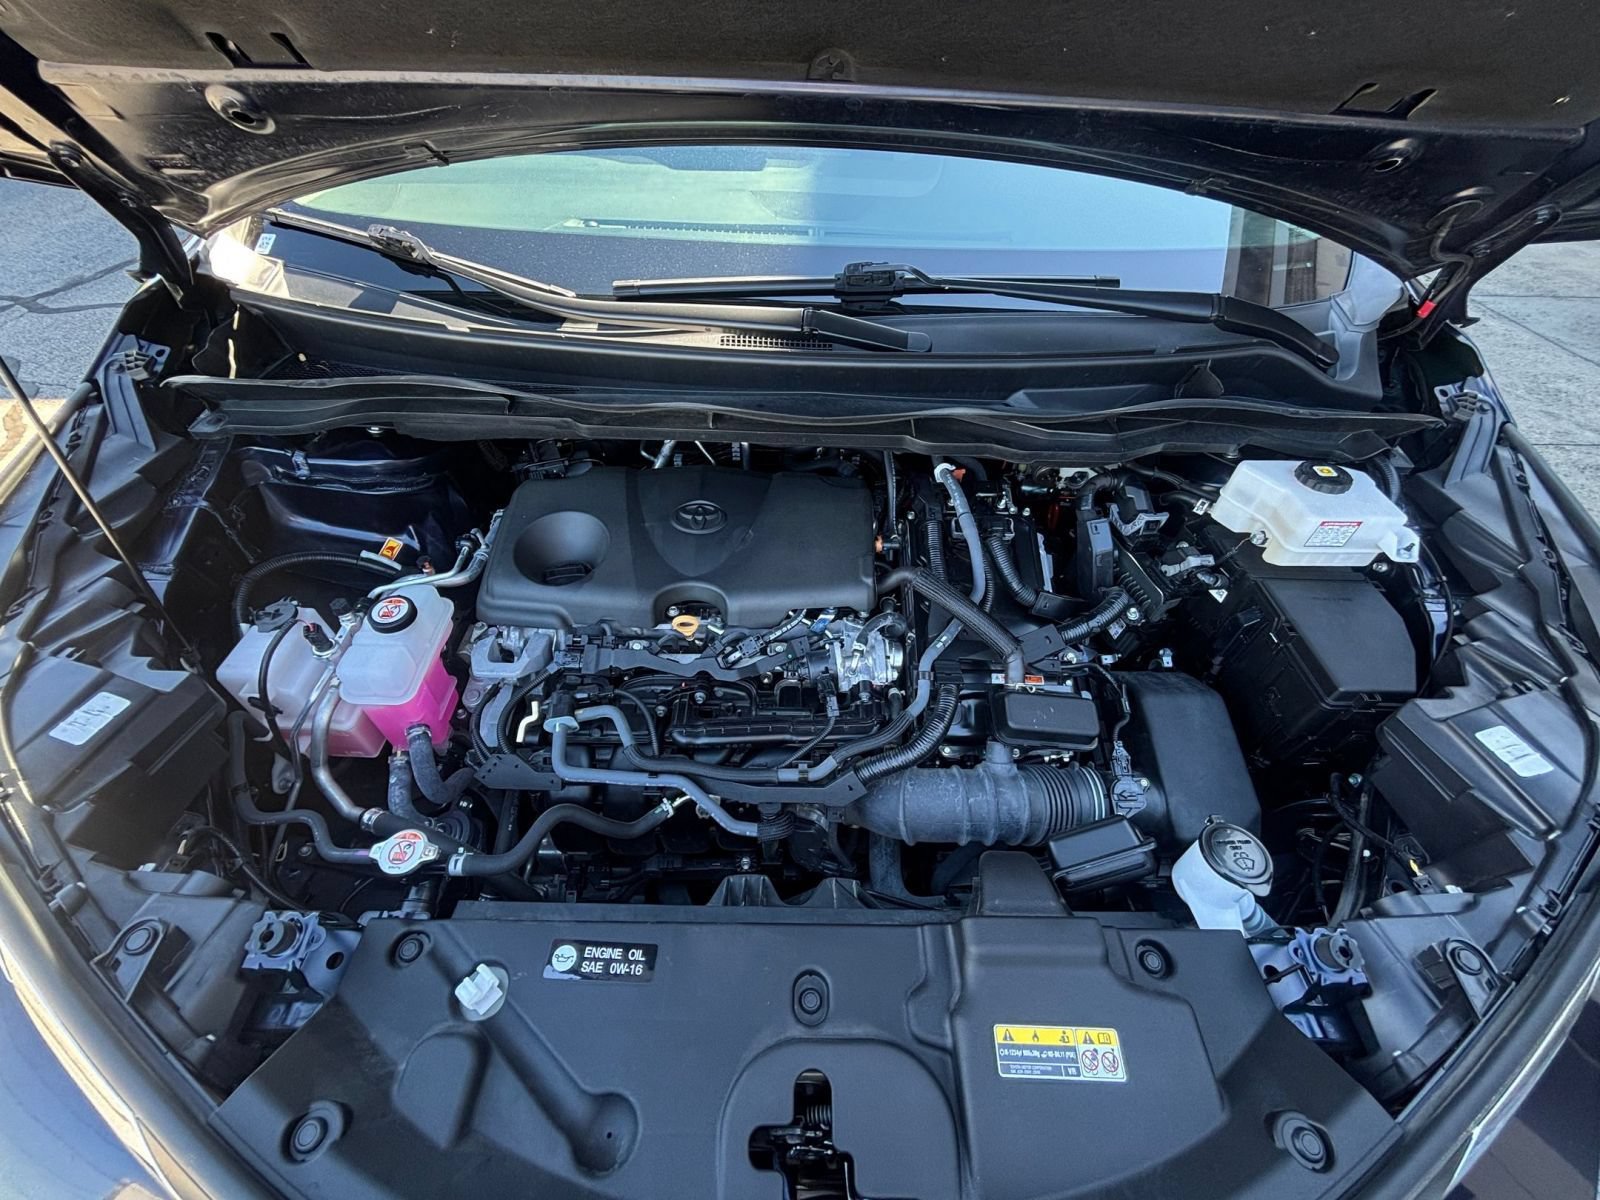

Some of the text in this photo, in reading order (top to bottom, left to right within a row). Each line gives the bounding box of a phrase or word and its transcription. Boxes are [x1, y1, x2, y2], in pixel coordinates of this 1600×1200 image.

[584, 946, 646, 961] ENGINE OIL
[580, 961, 643, 976] SAE 0W-16
